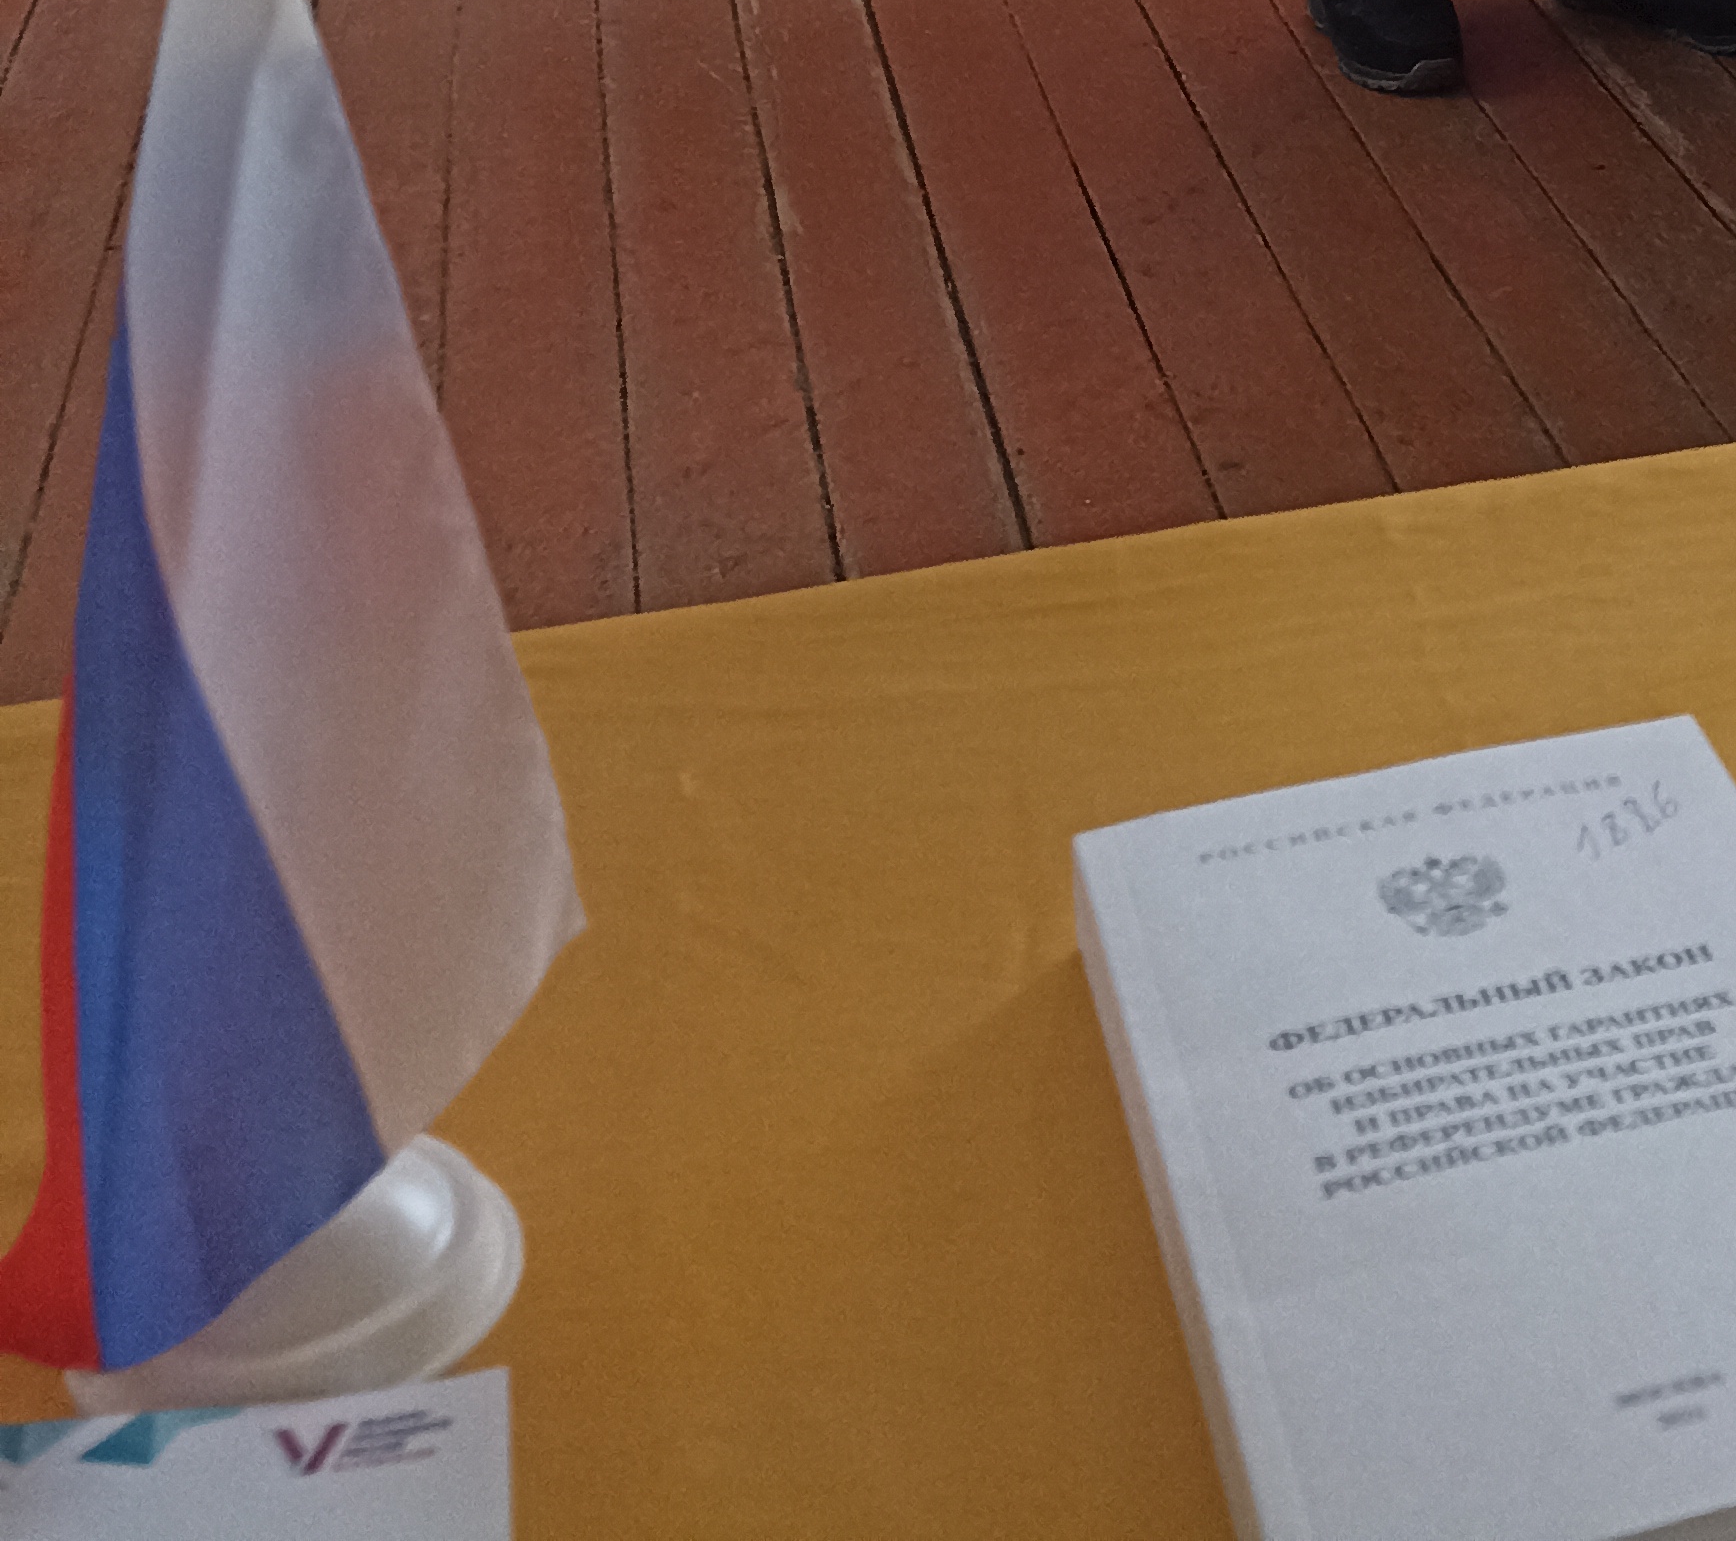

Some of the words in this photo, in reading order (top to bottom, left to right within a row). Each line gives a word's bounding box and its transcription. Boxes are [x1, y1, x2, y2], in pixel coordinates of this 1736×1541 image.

[1268, 968, 1573, 1051] ФЕДЕРАЛЬНЫЙ
[1580, 943, 1713, 987] ЗАКОН
[1288, 1076, 1336, 1099] ОБ
[1343, 1030, 1539, 1087] ОСНОВНЫХ
[1547, 989, 1736, 1042] ГАРАНТИЯХ
[1330, 1038, 1624, 1115] ИЗБИРАТЕЛЬНЫХ
[1631, 1020, 1717, 1050] ПРАВ
[1389, 1091, 1499, 1128] ПРАВА
[1506, 1078, 1555, 1102] НА
[1563, 1044, 1717, 1090] УЧАСТИЕ
[1320, 1123, 1569, 1200] РОССИЙСКОЙ
[1345, 1093, 1605, 1167] РЕФЕРЕНДУМЕ
